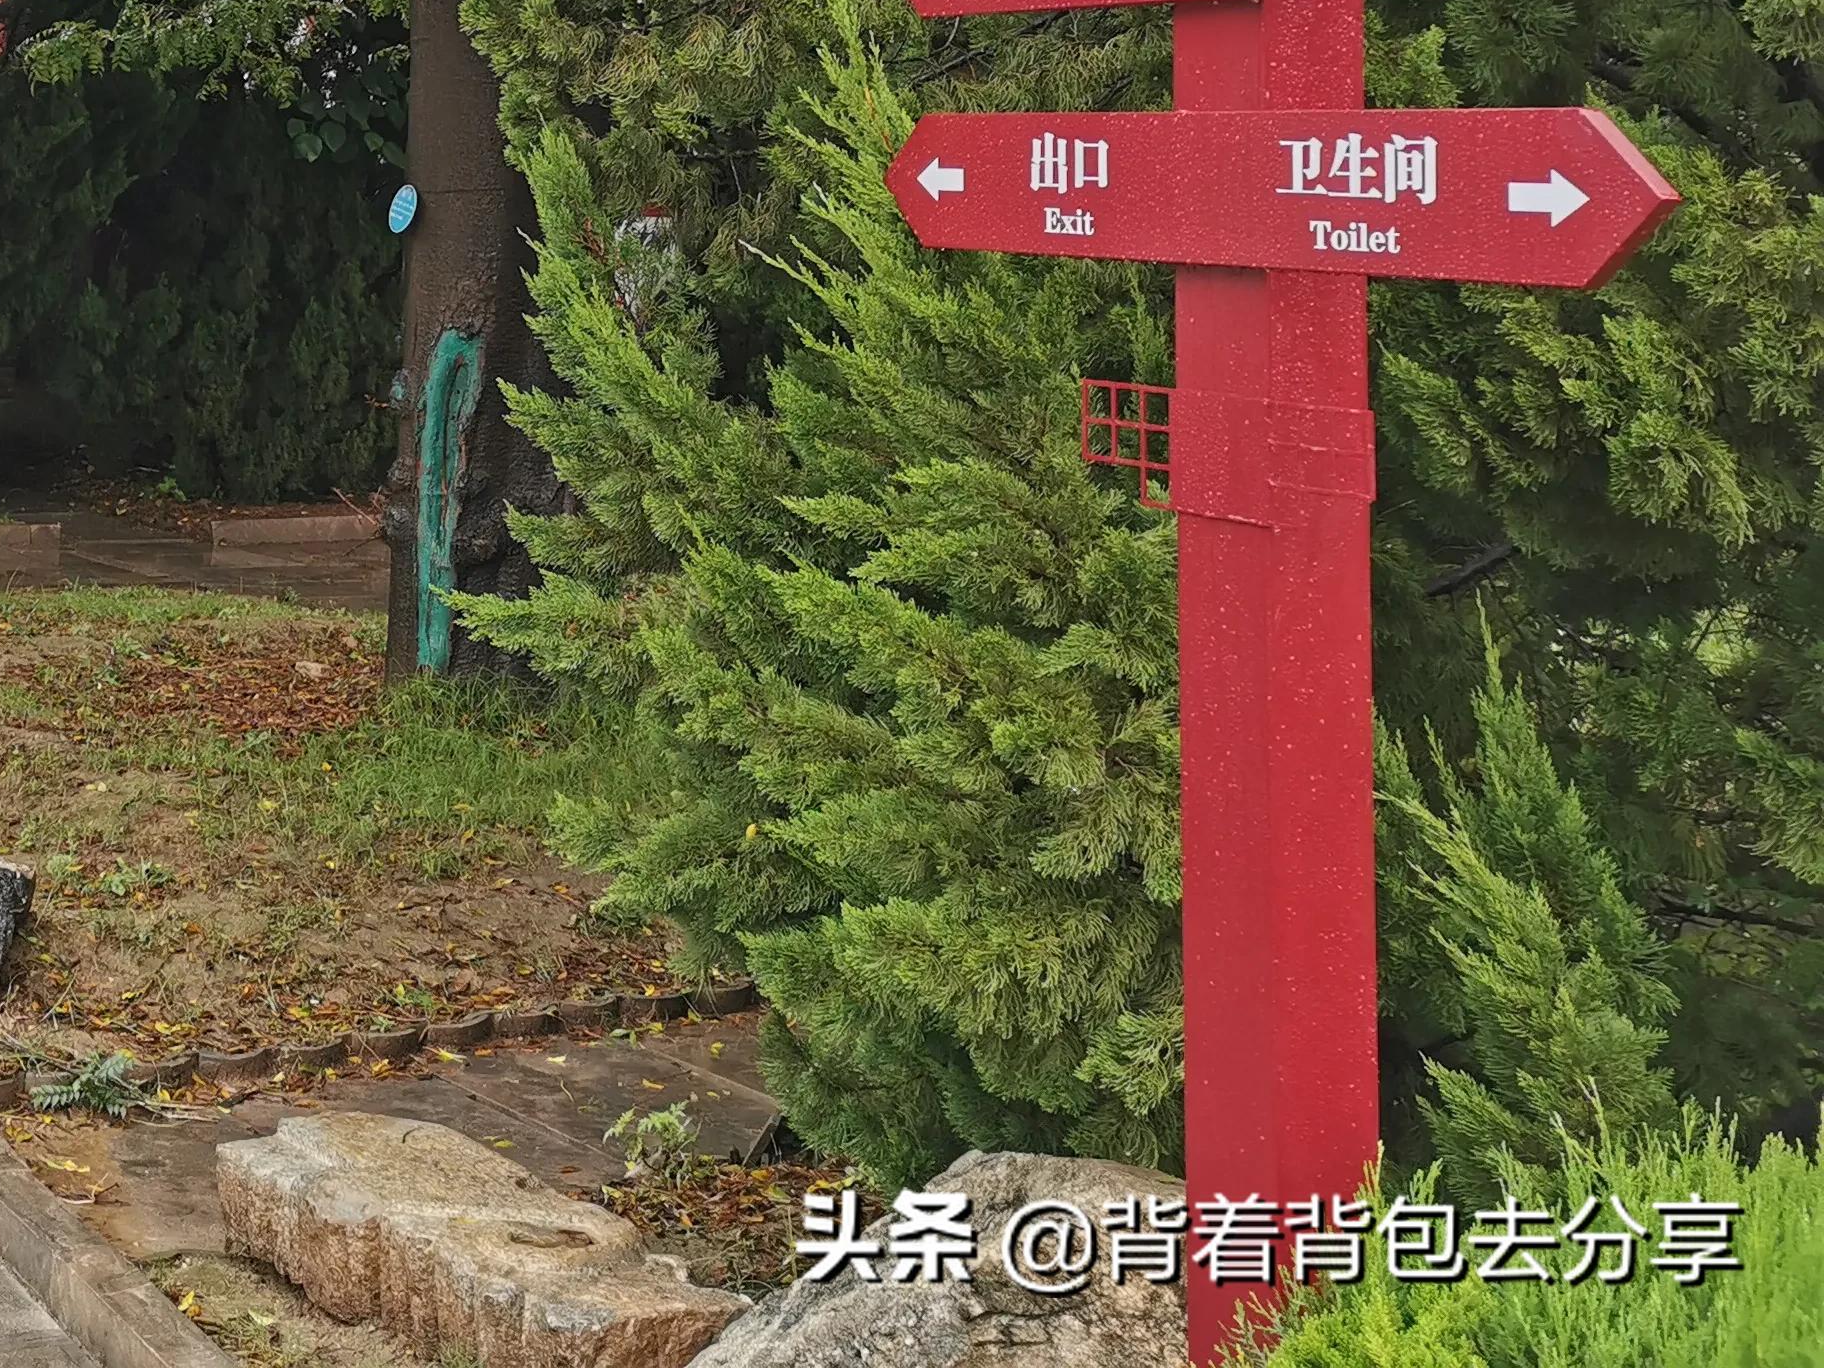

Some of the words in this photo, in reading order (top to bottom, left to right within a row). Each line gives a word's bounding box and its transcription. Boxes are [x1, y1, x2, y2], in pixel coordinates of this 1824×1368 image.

[1029, 131, 1109, 195] 出口
[1275, 132, 1439, 205] 卫生间
[1043, 207, 1095, 237] Exit
[1309, 220, 1401, 255] Toilet
